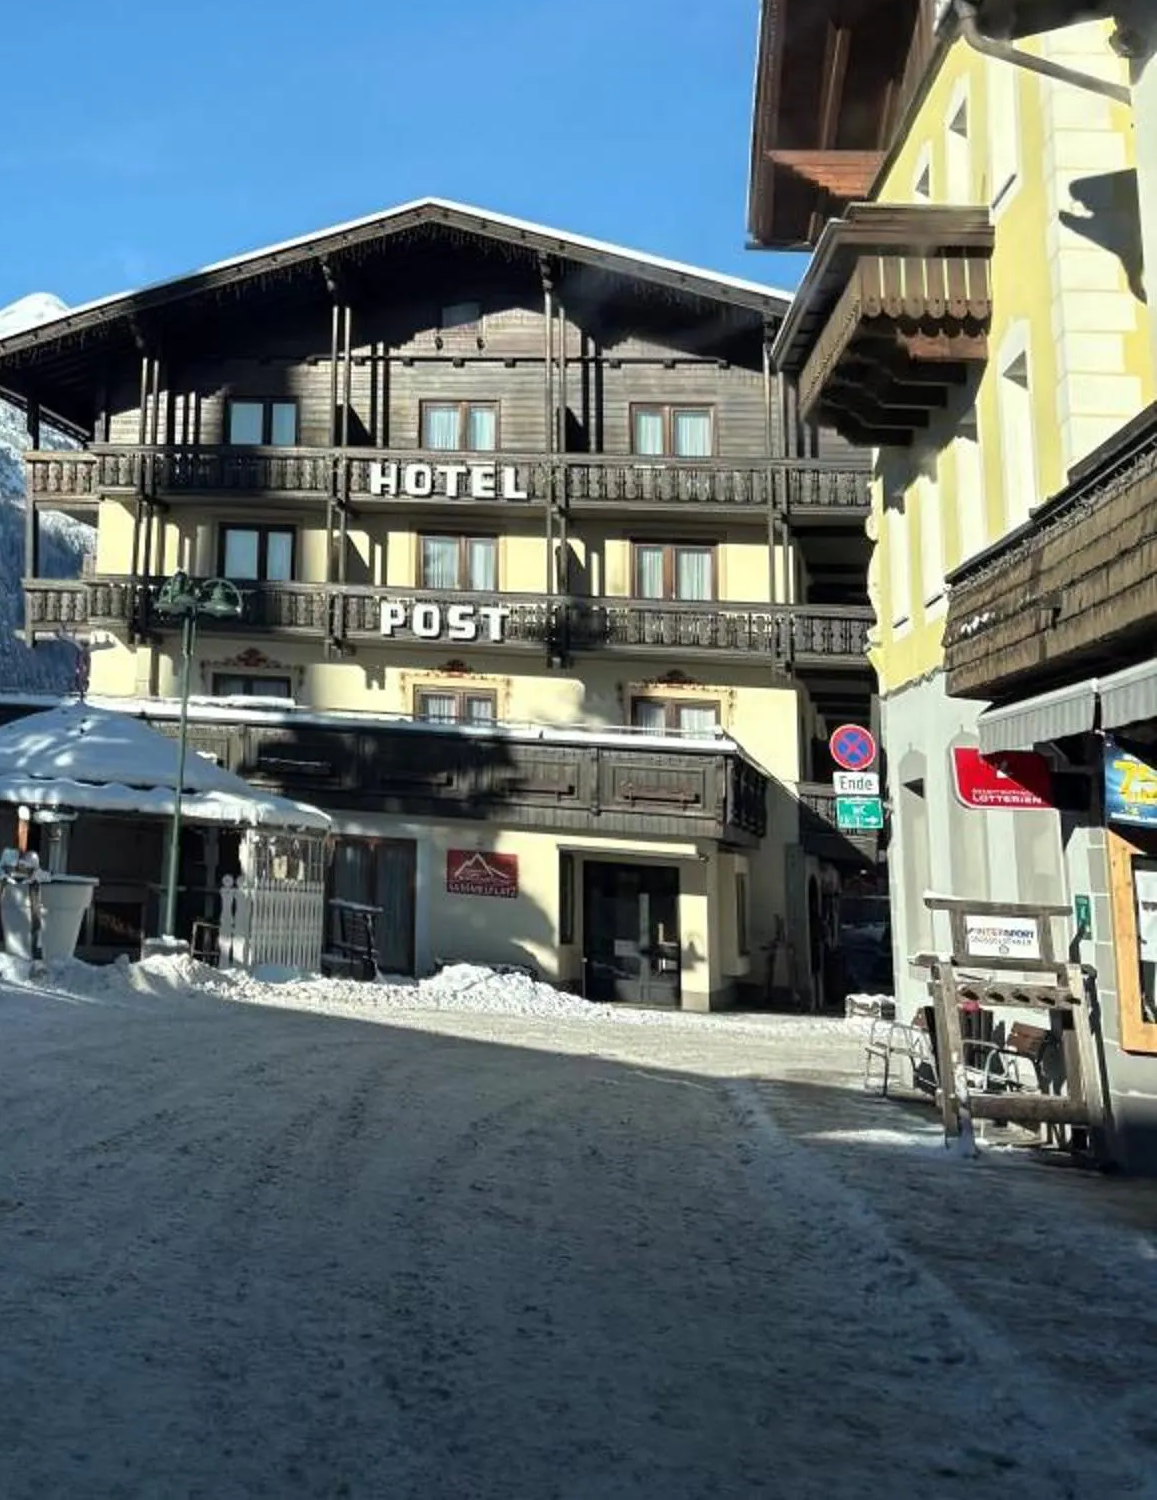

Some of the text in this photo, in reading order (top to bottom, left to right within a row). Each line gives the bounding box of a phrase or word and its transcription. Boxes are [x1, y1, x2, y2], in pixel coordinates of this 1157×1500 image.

[370, 462, 528, 499] HOTEL
[379, 599, 510, 641] POST
[839, 776, 874, 791] Ende
[971, 793, 1043, 804] LOTTERIEN
